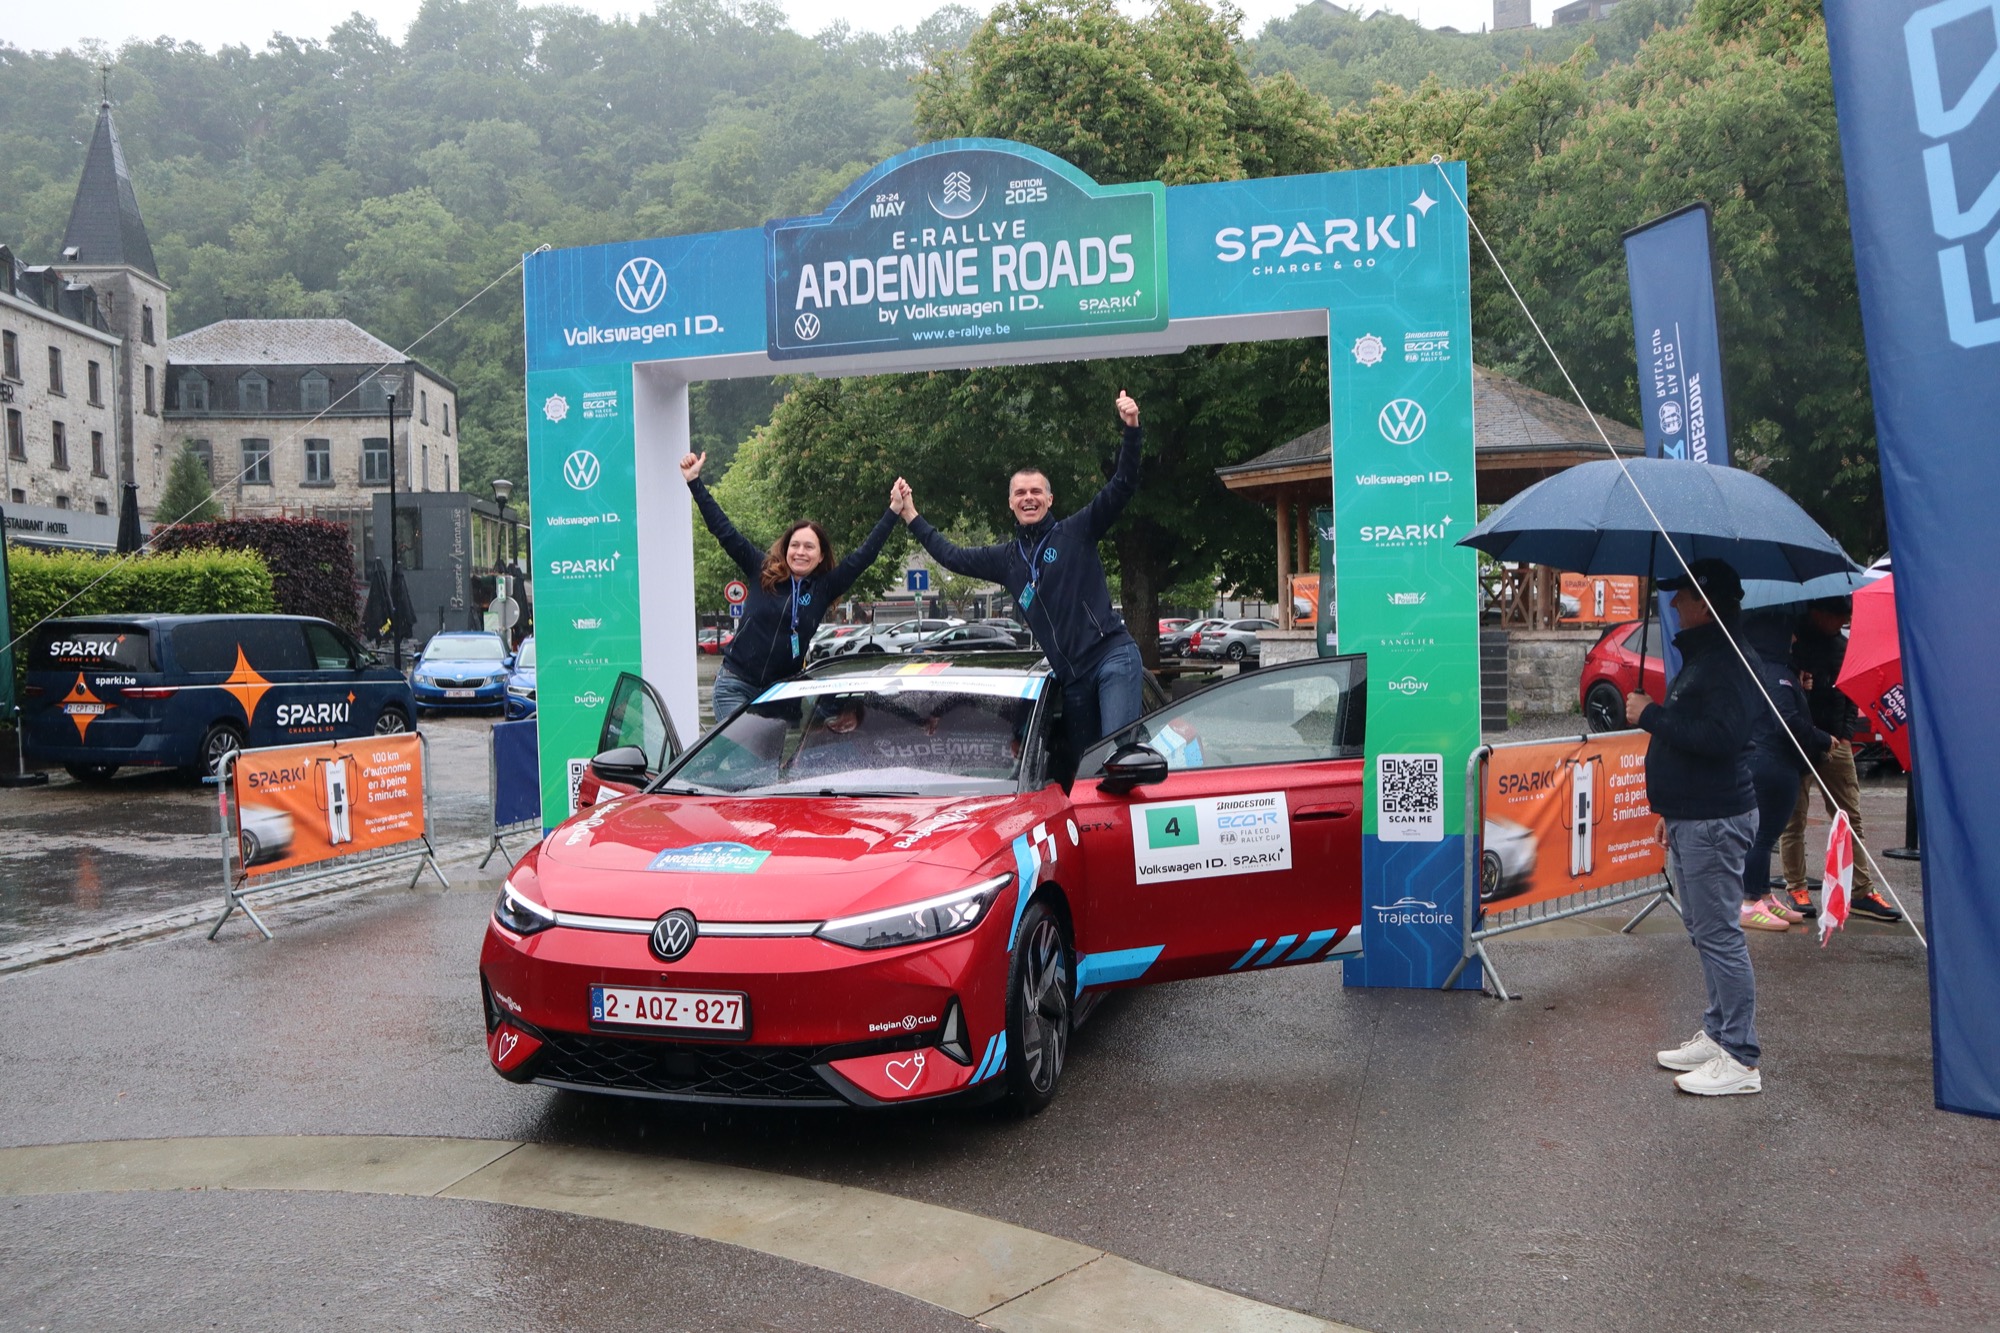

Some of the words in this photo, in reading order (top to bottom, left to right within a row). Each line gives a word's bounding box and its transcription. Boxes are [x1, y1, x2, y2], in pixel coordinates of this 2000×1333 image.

[1009, 178, 1043, 188] EDITION
[875, 193, 900, 203] 22-24
[1005, 187, 1048, 205] 2025
[870, 201, 906, 219] MAY
[892, 219, 1026, 250] E-RALLYE
[1215, 213, 1416, 262] SPARKI
[795, 247, 980, 310] ARDENNE
[992, 234, 1135, 293] ROADS
[1252, 262, 1322, 276] CHARGE
[1333, 260, 1342, 270] &
[1353, 258, 1376, 268] GO
[878, 305, 898, 324] by
[903, 299, 1003, 321] Volkswagen
[1009, 294, 1044, 312] ID.
[1079, 295, 1137, 311] SPARKI
[563, 322, 677, 346] Volkswagen
[684, 315, 724, 336] ID.
[912, 323, 1010, 342] www.e-rallye.be
[1404, 330, 1450, 340] BRIDGESTONE
[1355, 473, 1425, 486] Volkswagen
[1428, 471, 1453, 483] ID.
[4, 516, 43, 531] ESTAURANT
[47, 521, 68, 534] HOTEL
[546, 515, 599, 527] Volkswagen
[602, 512, 621, 523] ID.
[1360, 523, 1444, 542] SPARKI
[550, 558, 615, 575] SPARKI
[50, 641, 118, 657] SPARKI
[1381, 638, 1434, 646] SANGLIER
[95, 676, 136, 687] sparki.be
[1388, 681, 1429, 692] Durbuy
[574, 694, 605, 705] Durbuy
[276, 702, 349, 726] SPARKI
[372, 752, 387, 763] 100
[387, 751, 399, 761] km
[1620, 754, 1634, 768] 100
[248, 766, 306, 788] SPARKI
[363, 761, 411, 778] d'autonomie
[368, 781, 379, 790] en
[386, 775, 407, 790] peine
[368, 791, 374, 803] 5
[374, 788, 409, 801] minutes.
[1614, 792, 1624, 804] en
[1630, 787, 1647, 805] pein
[1216, 798, 1276, 811] BRIDGESTONE
[1388, 815, 1415, 823] SCAN
[1418, 815, 1433, 823] ME
[1613, 808, 1618, 821] 5
[1619, 805, 1652, 820] minutes.
[1080, 822, 1114, 833] GTX
[1164, 817, 1181, 837] 4
[1254, 827, 1270, 835] ECO
[662, 855, 713, 864] ARDENNE
[715, 856, 756, 865] ROADS
[1138, 860, 1202, 876] Volkswagen
[1205, 858, 1227, 869] ID.
[1233, 852, 1281, 866] SPARKI
[1377, 910, 1453, 927] trajectoire
[594, 1006, 603, 1018] B
[869, 1020, 901, 1032] Belgian
[918, 1014, 937, 1024] Club
